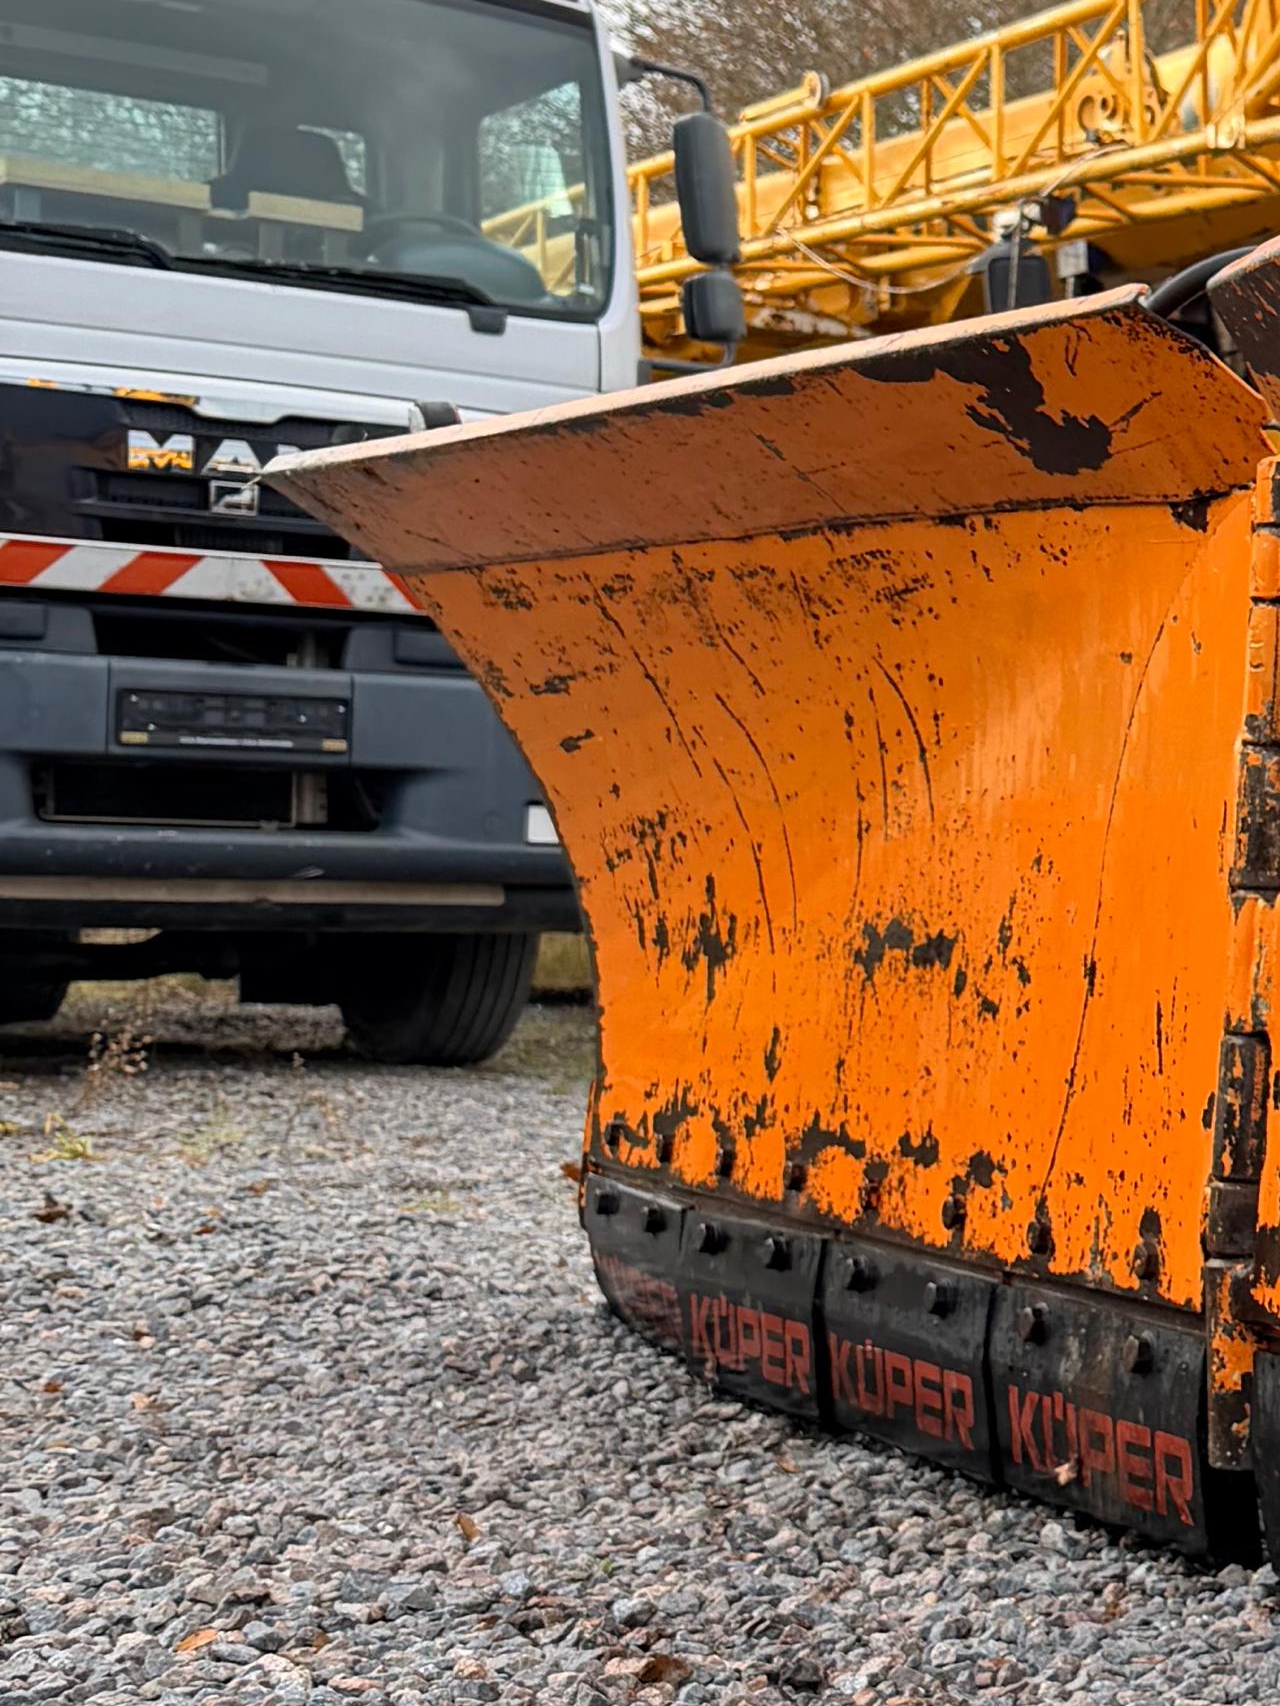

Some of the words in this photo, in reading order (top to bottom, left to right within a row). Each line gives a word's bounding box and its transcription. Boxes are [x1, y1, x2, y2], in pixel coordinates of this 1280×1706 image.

[127, 429, 303, 475] MA
[690, 1292, 811, 1395] KÜPER
[828, 1330, 974, 1451] KÜPER
[1008, 1384, 1195, 1526] KÜPER
